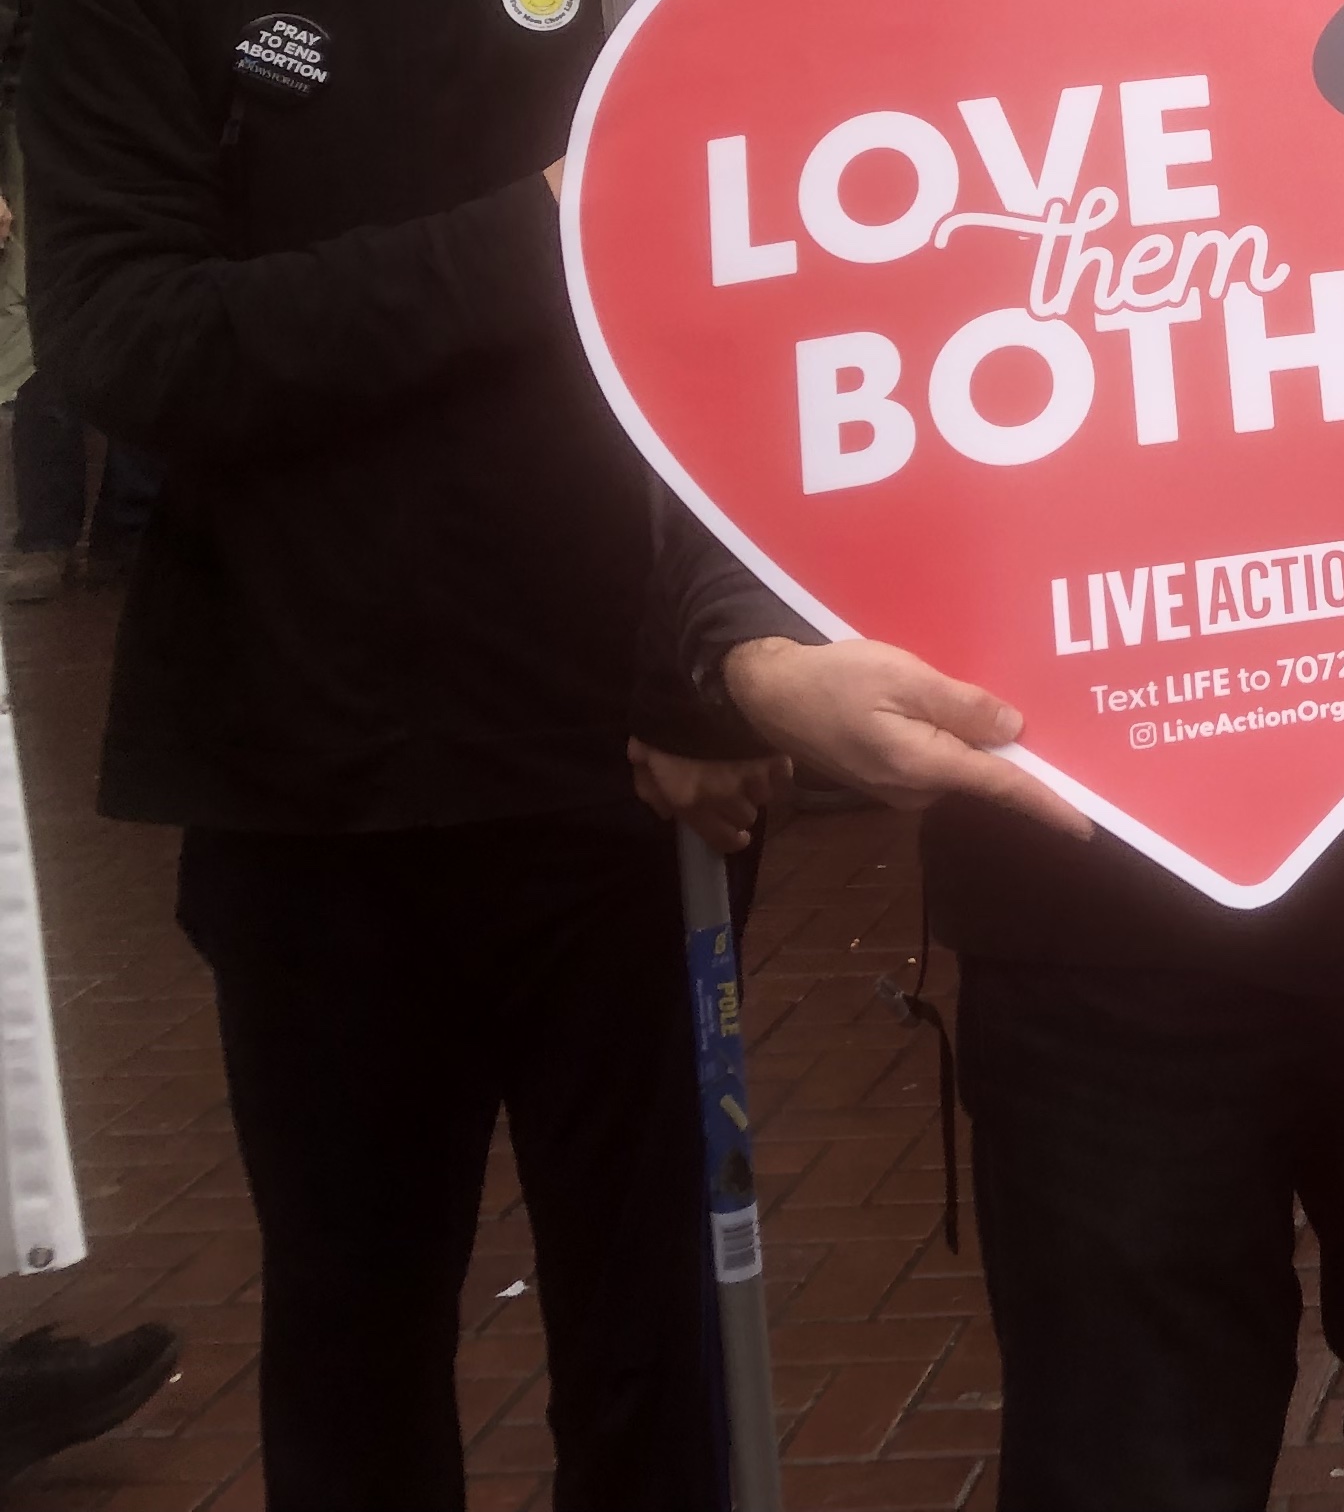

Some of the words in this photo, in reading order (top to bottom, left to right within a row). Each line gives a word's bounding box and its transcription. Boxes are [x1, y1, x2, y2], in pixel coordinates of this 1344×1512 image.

[258, 30, 283, 49] TO
[283, 41, 322, 64] END
[272, 20, 322, 47] PRAY
[234, 40, 328, 84] ABORTION
[707, 74, 1220, 286] LOVE
[935, 186, 1290, 318] them
[1051, 562, 1192, 656] LIVE
[1090, 681, 1159, 714] Text
[1166, 667, 1231, 704] LIFE
[1238, 667, 1271, 694] to
